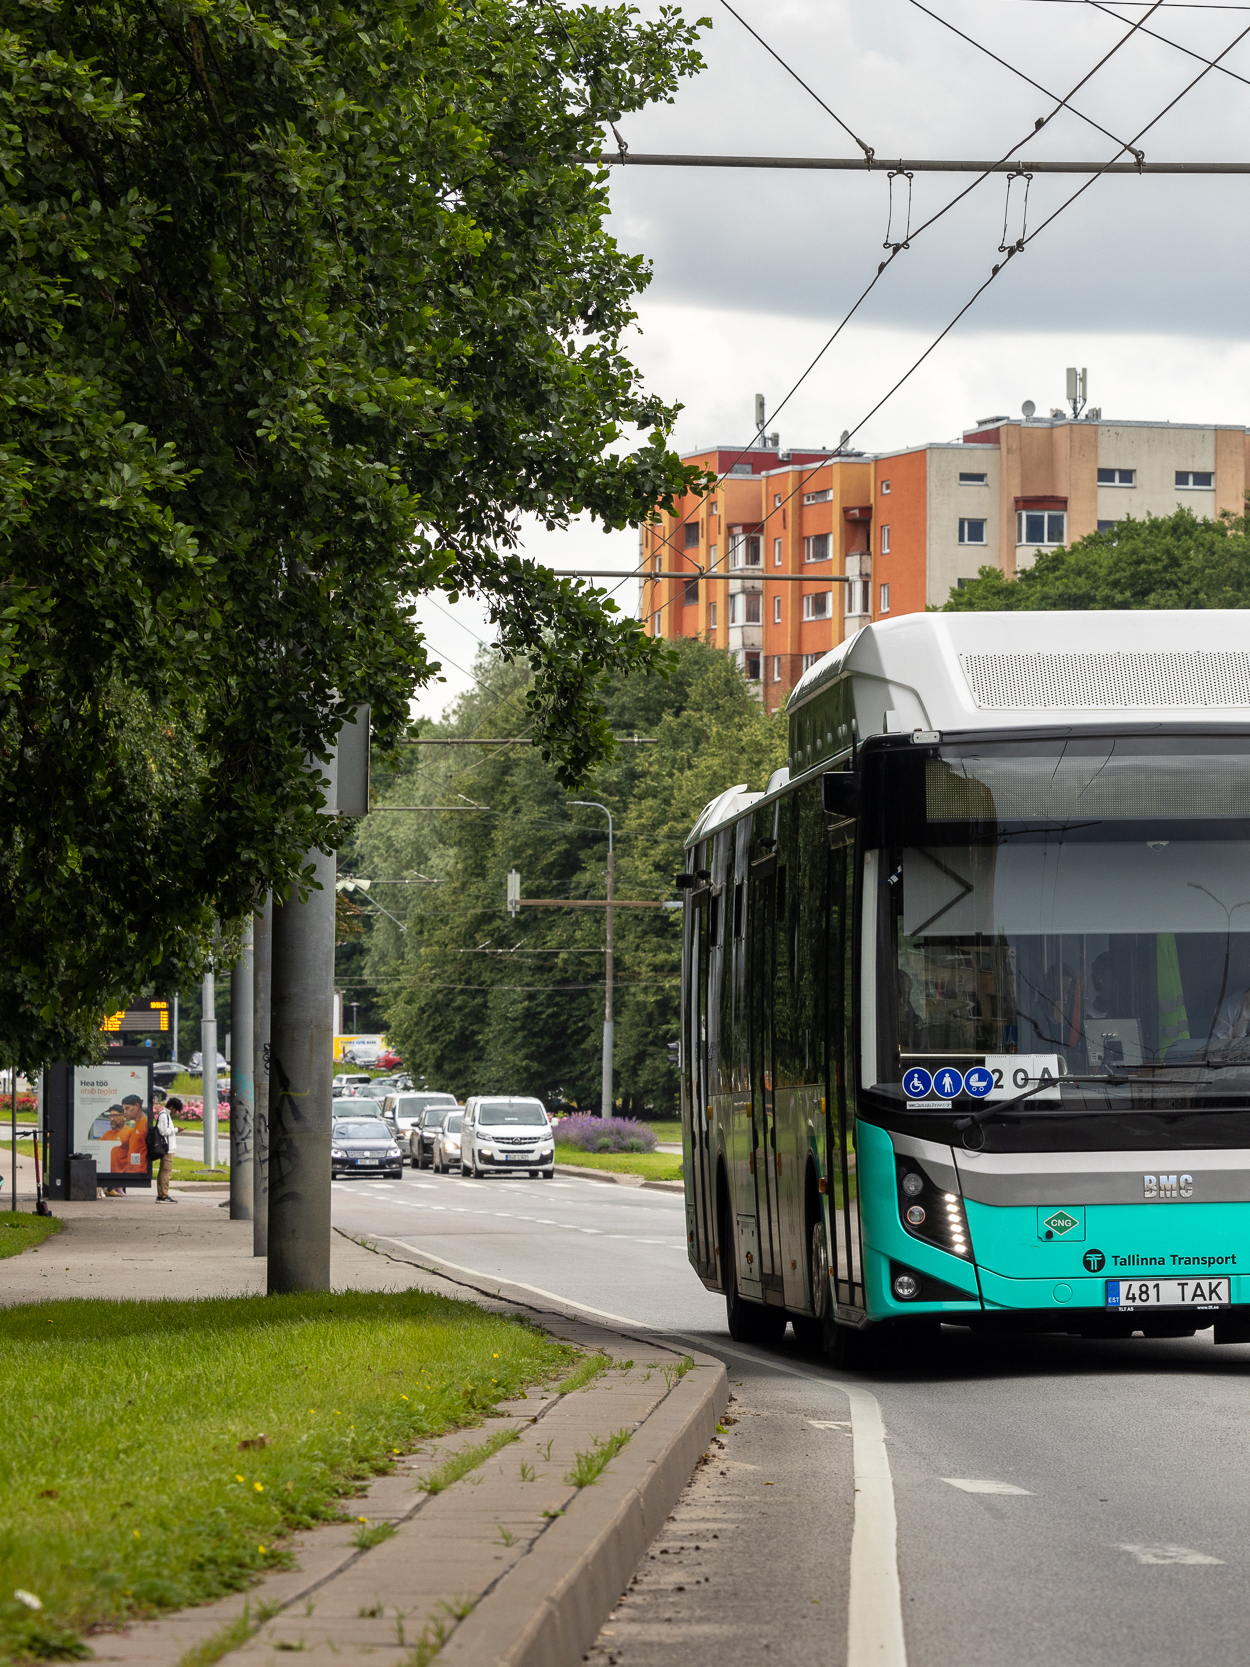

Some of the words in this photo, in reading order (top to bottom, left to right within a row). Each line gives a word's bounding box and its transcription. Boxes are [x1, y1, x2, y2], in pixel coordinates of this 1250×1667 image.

[1143, 1174, 1193, 1198] BMC
[1050, 1218, 1072, 1227] CNG
[1111, 1255, 1166, 1267] Tallinna
[1170, 1254, 1237, 1268] Transport
[1125, 1283, 1161, 1304] 481
[1177, 1281, 1223, 1303] TAK
